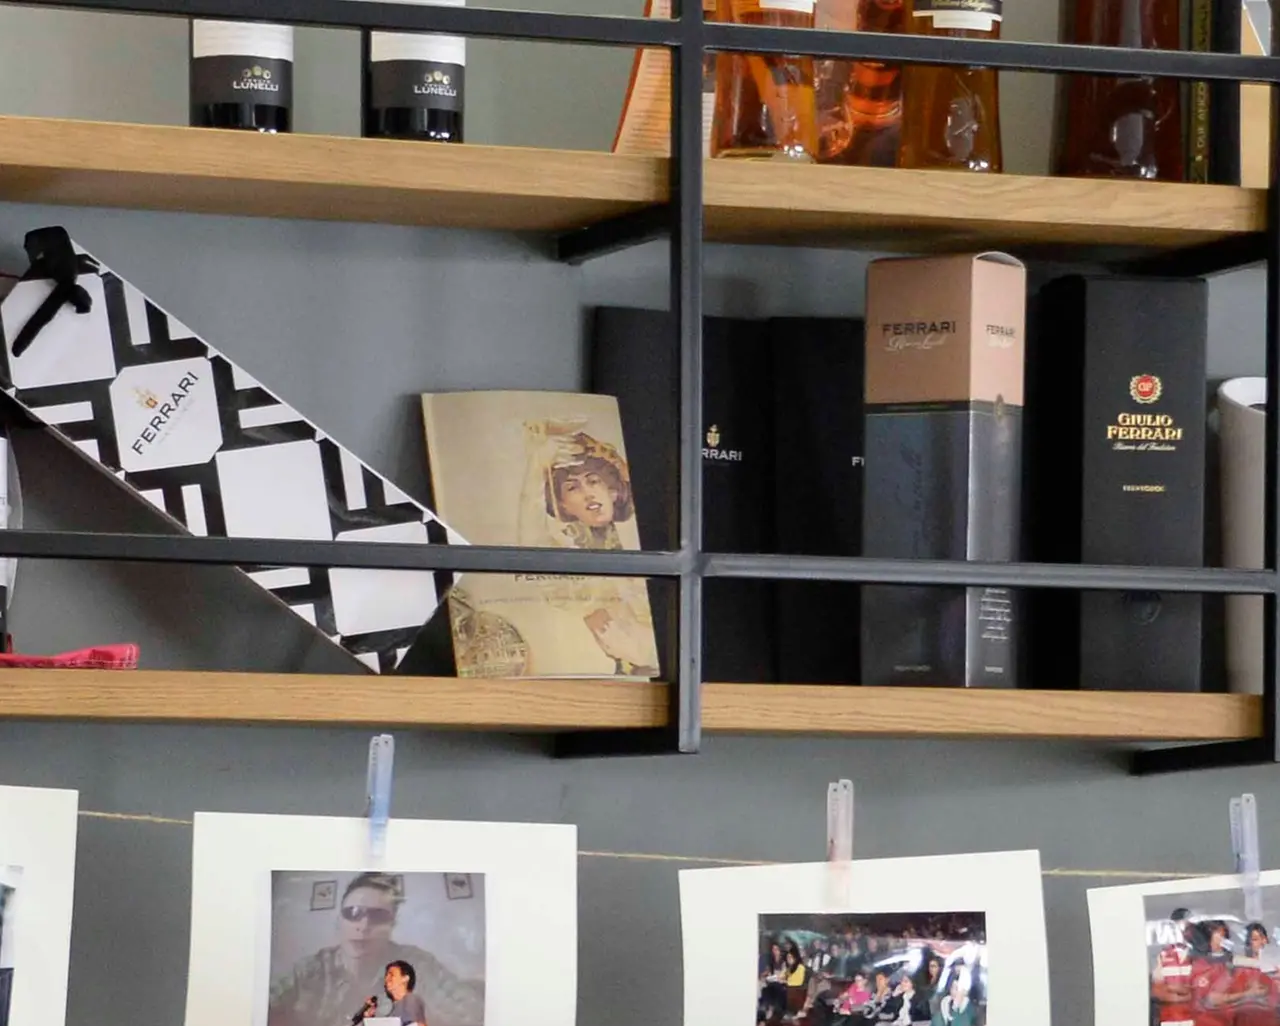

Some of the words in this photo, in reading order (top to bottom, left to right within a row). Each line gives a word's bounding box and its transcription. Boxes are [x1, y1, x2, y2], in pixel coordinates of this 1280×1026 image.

[233, 80, 279, 92] LUNELLI
[414, 84, 456, 97] LUNELLI
[882, 321, 957, 336] FERRARI
[131, 371, 199, 455] FERRARI
[1118, 412, 1174, 427] GIULIO
[1106, 425, 1183, 441] FERRARI
[702, 449, 743, 461] RRARI
